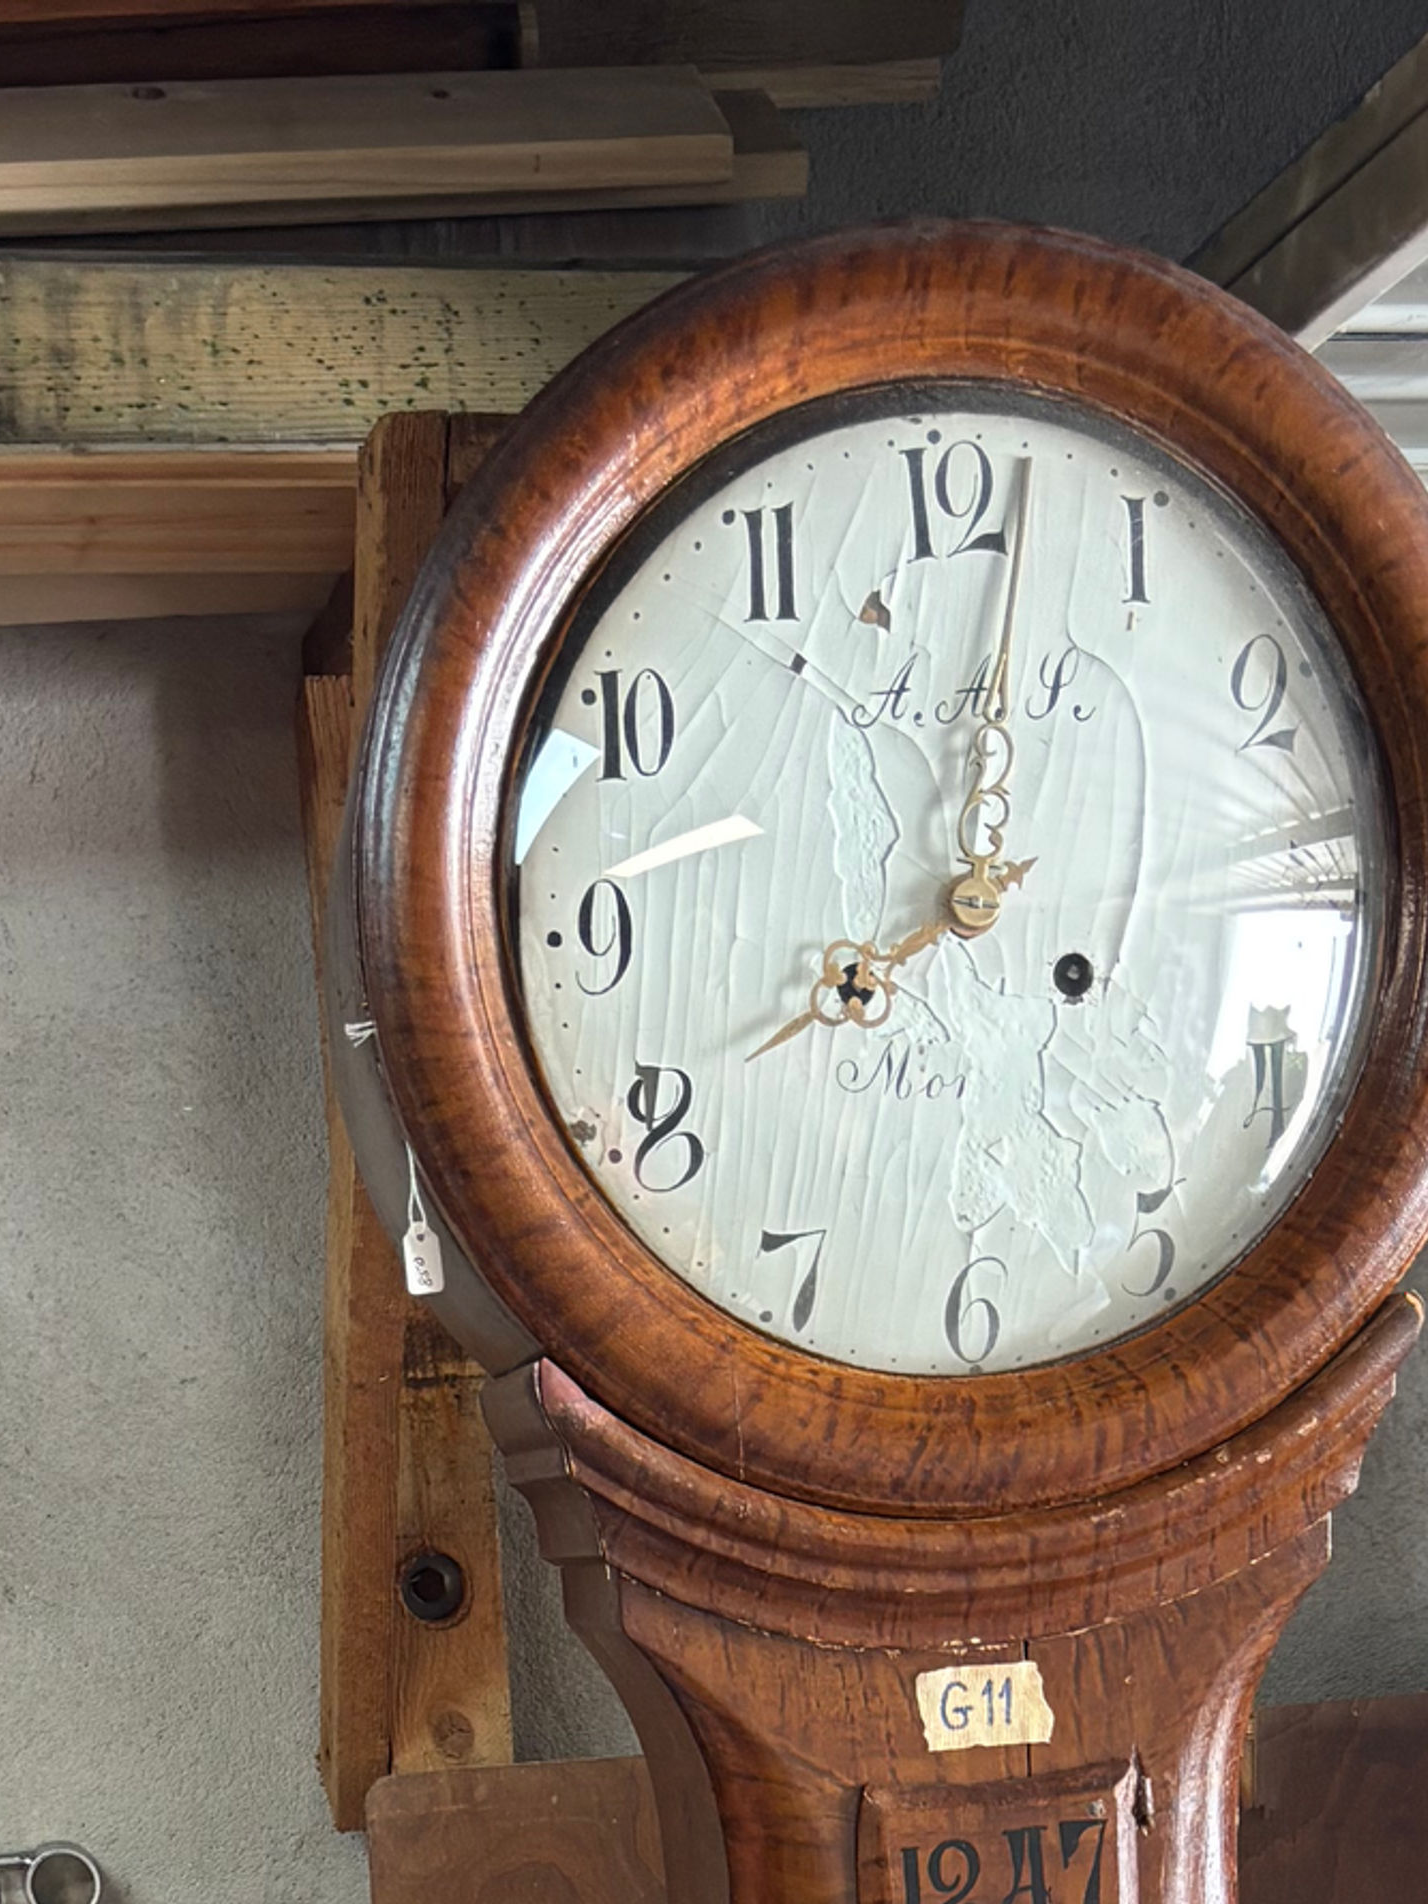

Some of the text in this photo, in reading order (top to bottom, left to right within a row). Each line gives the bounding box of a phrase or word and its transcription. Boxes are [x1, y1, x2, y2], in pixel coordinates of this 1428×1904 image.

[898, 439, 1009, 564] 12
[1120, 494, 1151, 605] 1
[741, 501, 801, 624] 11
[593, 667, 675, 782] 10
[1230, 633, 1302, 756] 2
[575, 878, 633, 995] 9
[626, 1061, 705, 1193] 8
[756, 1229, 828, 1333] 7
[1121, 1178, 1187, 1297] 5
[945, 1256, 1009, 1364] 6
[939, 1676, 1014, 1731] G11
